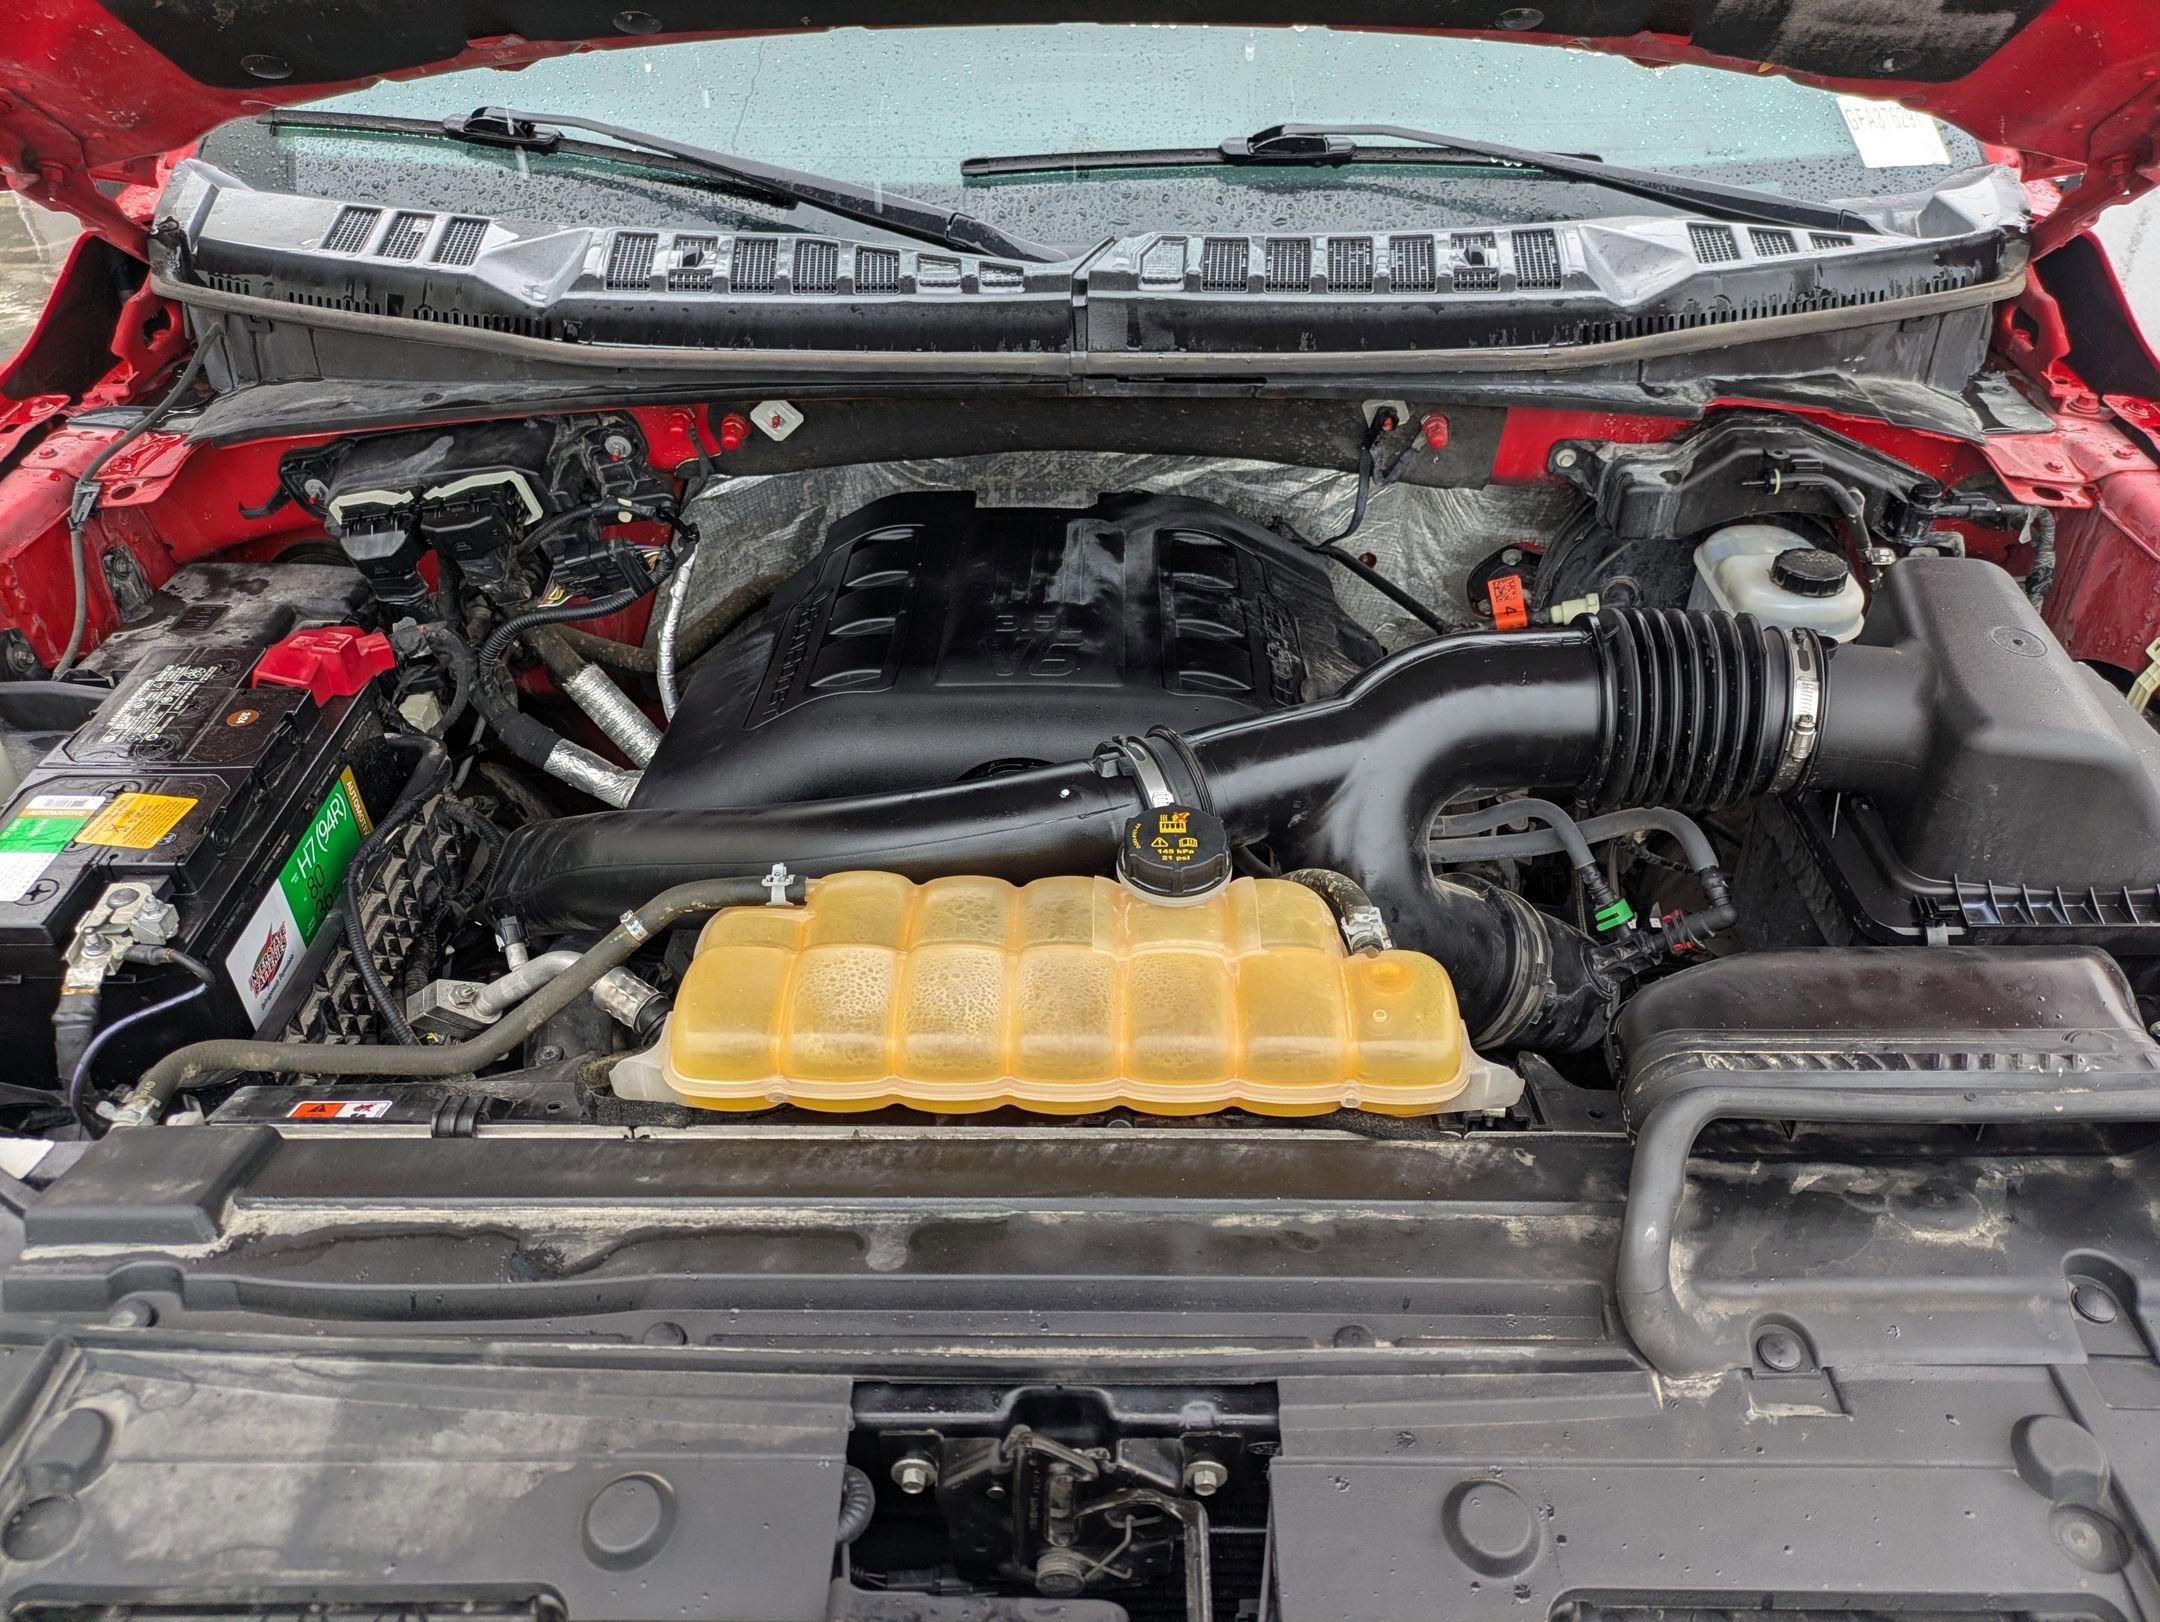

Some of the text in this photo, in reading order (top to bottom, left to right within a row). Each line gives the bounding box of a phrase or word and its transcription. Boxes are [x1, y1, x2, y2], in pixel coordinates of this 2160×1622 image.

[982, 636, 1085, 677] V6
[297, 792, 348, 879] H7 (94R)
[346, 780, 371, 837] AUTOMOTIV
[307, 863, 326, 899] 80
[248, 920, 287, 991] INTERSTATE
[253, 937, 288, 999] BATTERIES
